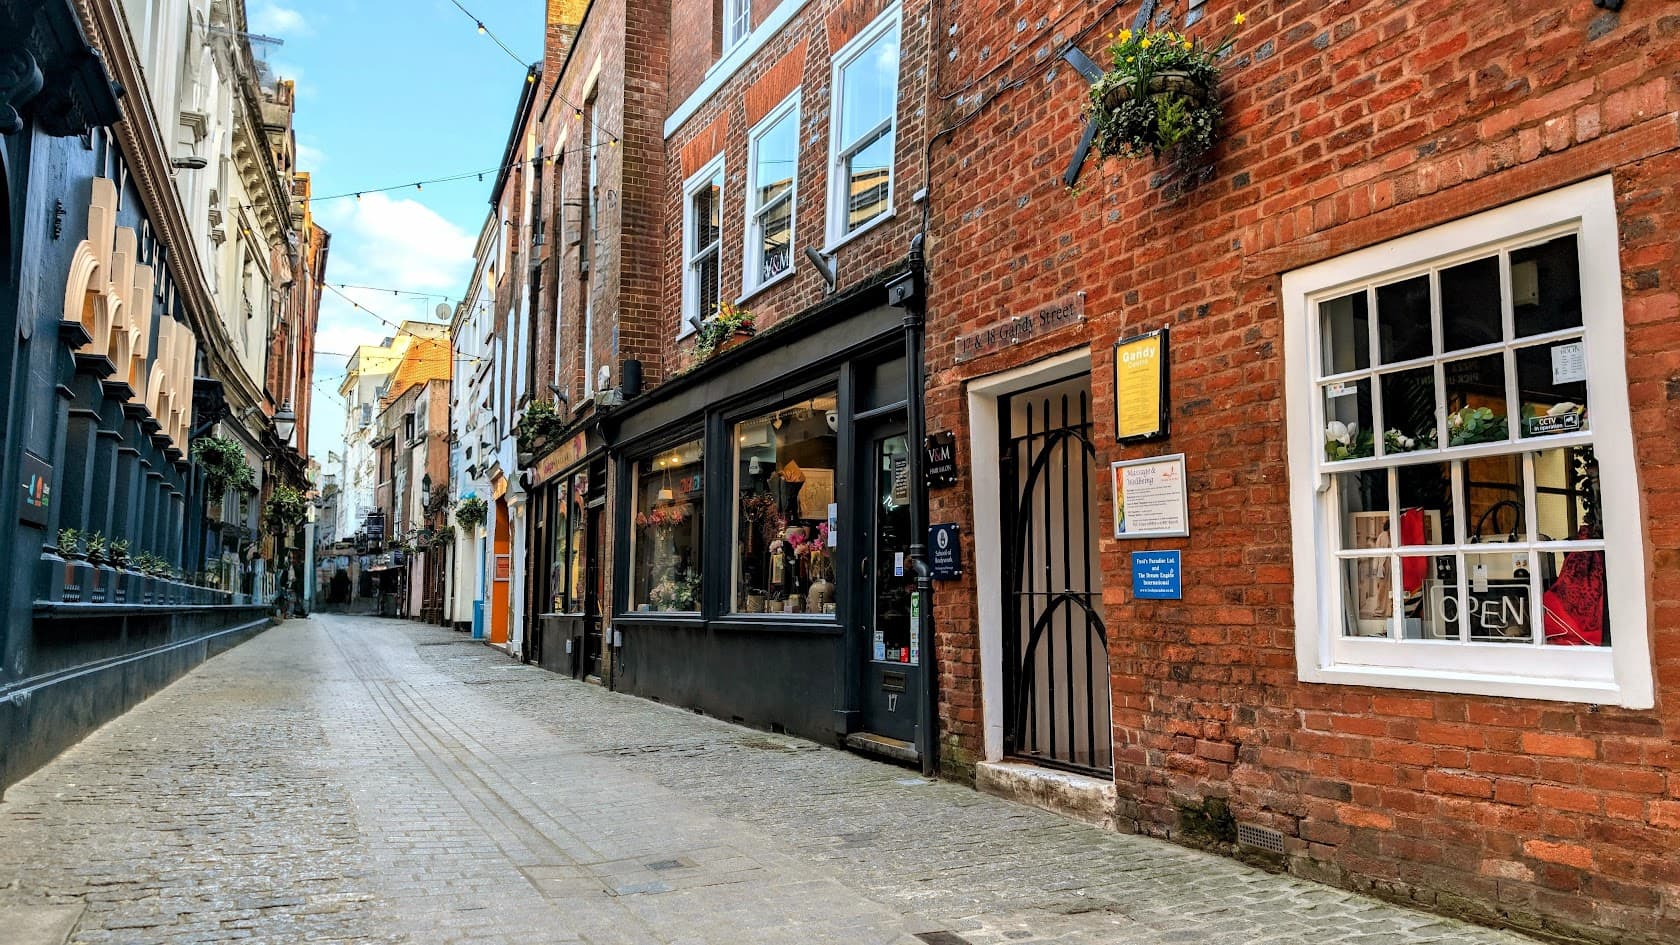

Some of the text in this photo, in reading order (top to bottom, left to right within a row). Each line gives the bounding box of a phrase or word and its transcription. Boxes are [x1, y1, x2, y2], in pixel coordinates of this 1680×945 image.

[765, 247, 789, 278] V&M
[962, 338, 971, 353] 17
[974, 335, 983, 350] &
[987, 329, 996, 345] 18
[999, 316, 1034, 340] Gandy
[1039, 303, 1075, 326] Street
[1122, 347, 1155, 362] Gandy
[1538, 416, 1557, 425] CCTV
[928, 445, 951, 463] V&M
[1440, 595, 1525, 628] OPEN
[888, 694, 898, 713] 17
